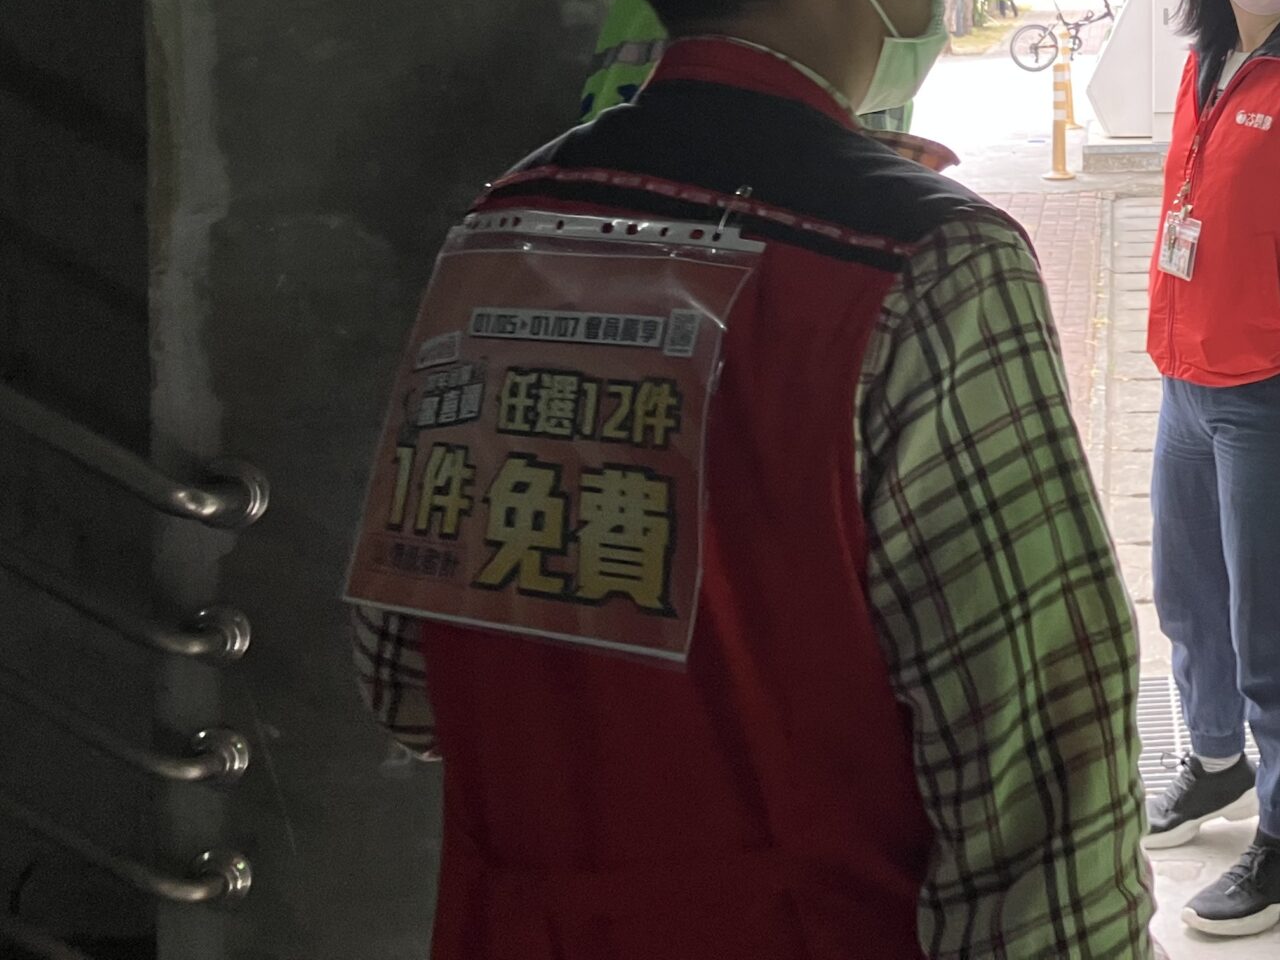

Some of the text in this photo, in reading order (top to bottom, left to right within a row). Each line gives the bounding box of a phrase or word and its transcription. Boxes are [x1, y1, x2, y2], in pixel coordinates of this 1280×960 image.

[530, 316, 581, 338] 01/07
[498, 369, 681, 446] 任選12件
[388, 444, 674, 615] 1件 免費
